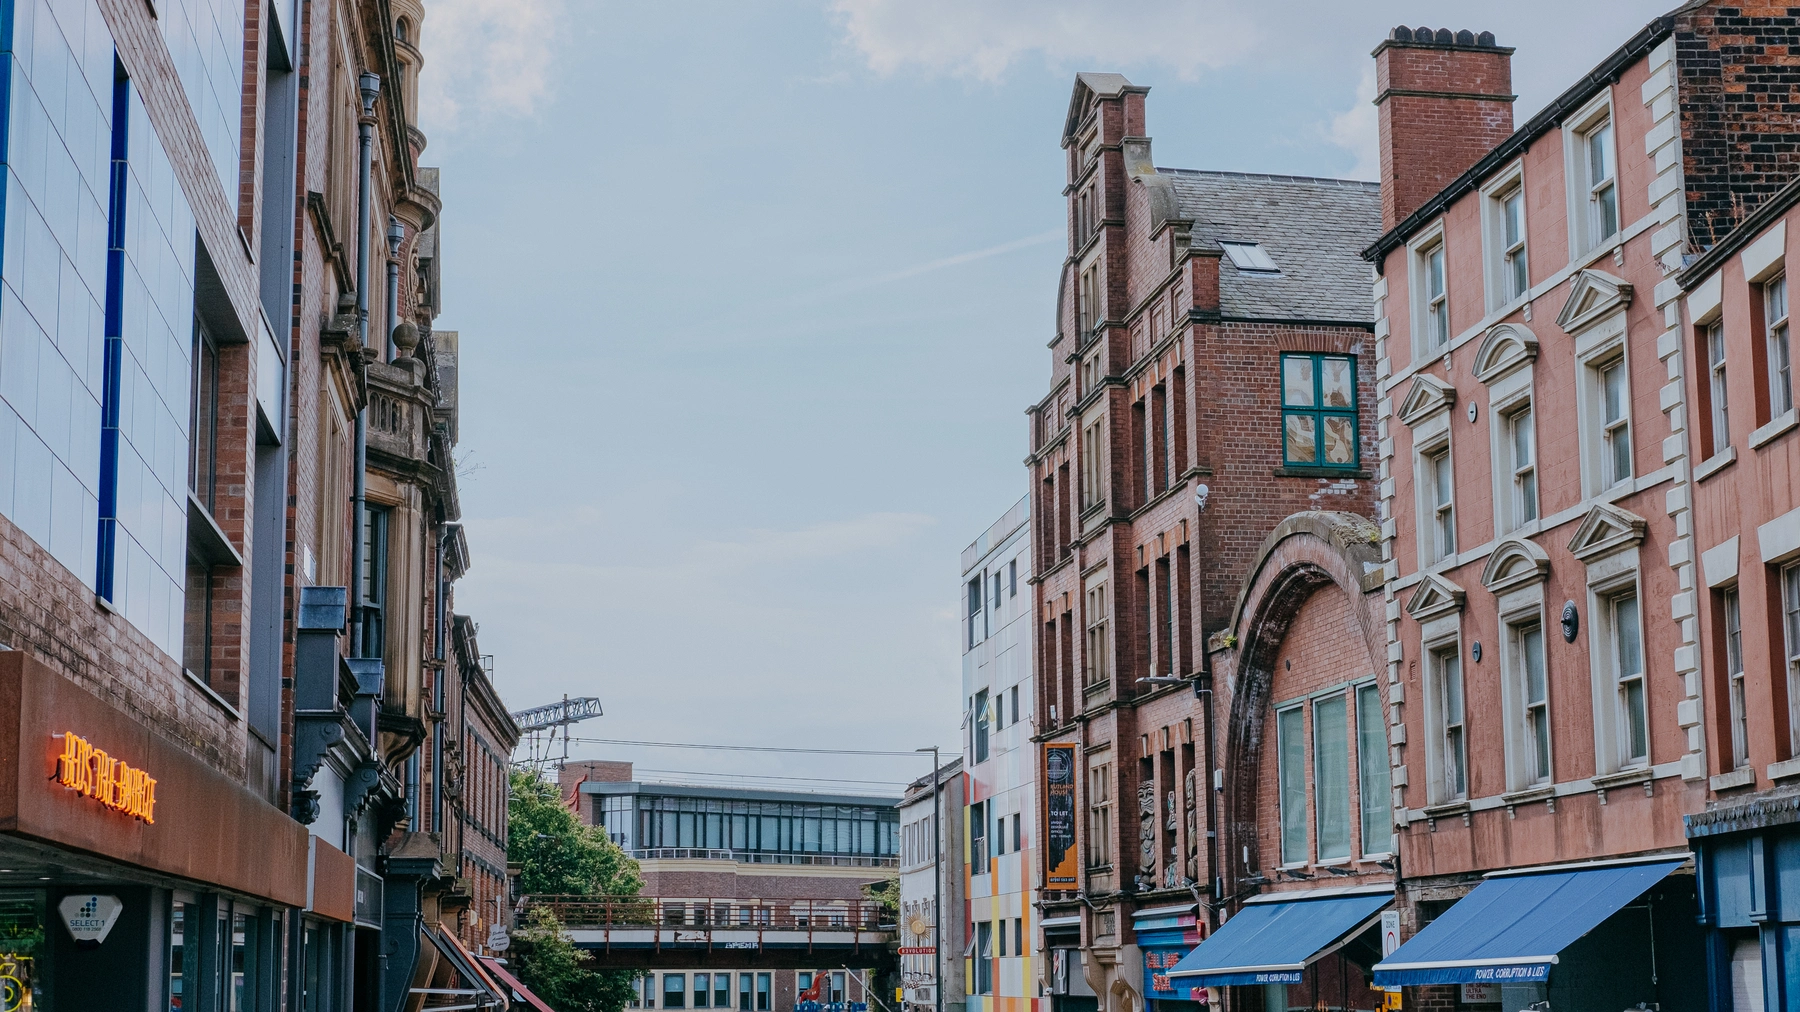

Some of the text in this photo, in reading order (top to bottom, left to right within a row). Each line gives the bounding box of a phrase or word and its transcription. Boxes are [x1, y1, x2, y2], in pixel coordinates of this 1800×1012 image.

[70, 919, 106, 927] SELECT 1
[1385, 920, 1396, 929] ZONE
[1495, 967, 1526, 979] CORRUPTION
[1527, 966, 1533, 977] &
[1532, 965, 1545, 977] LIES
